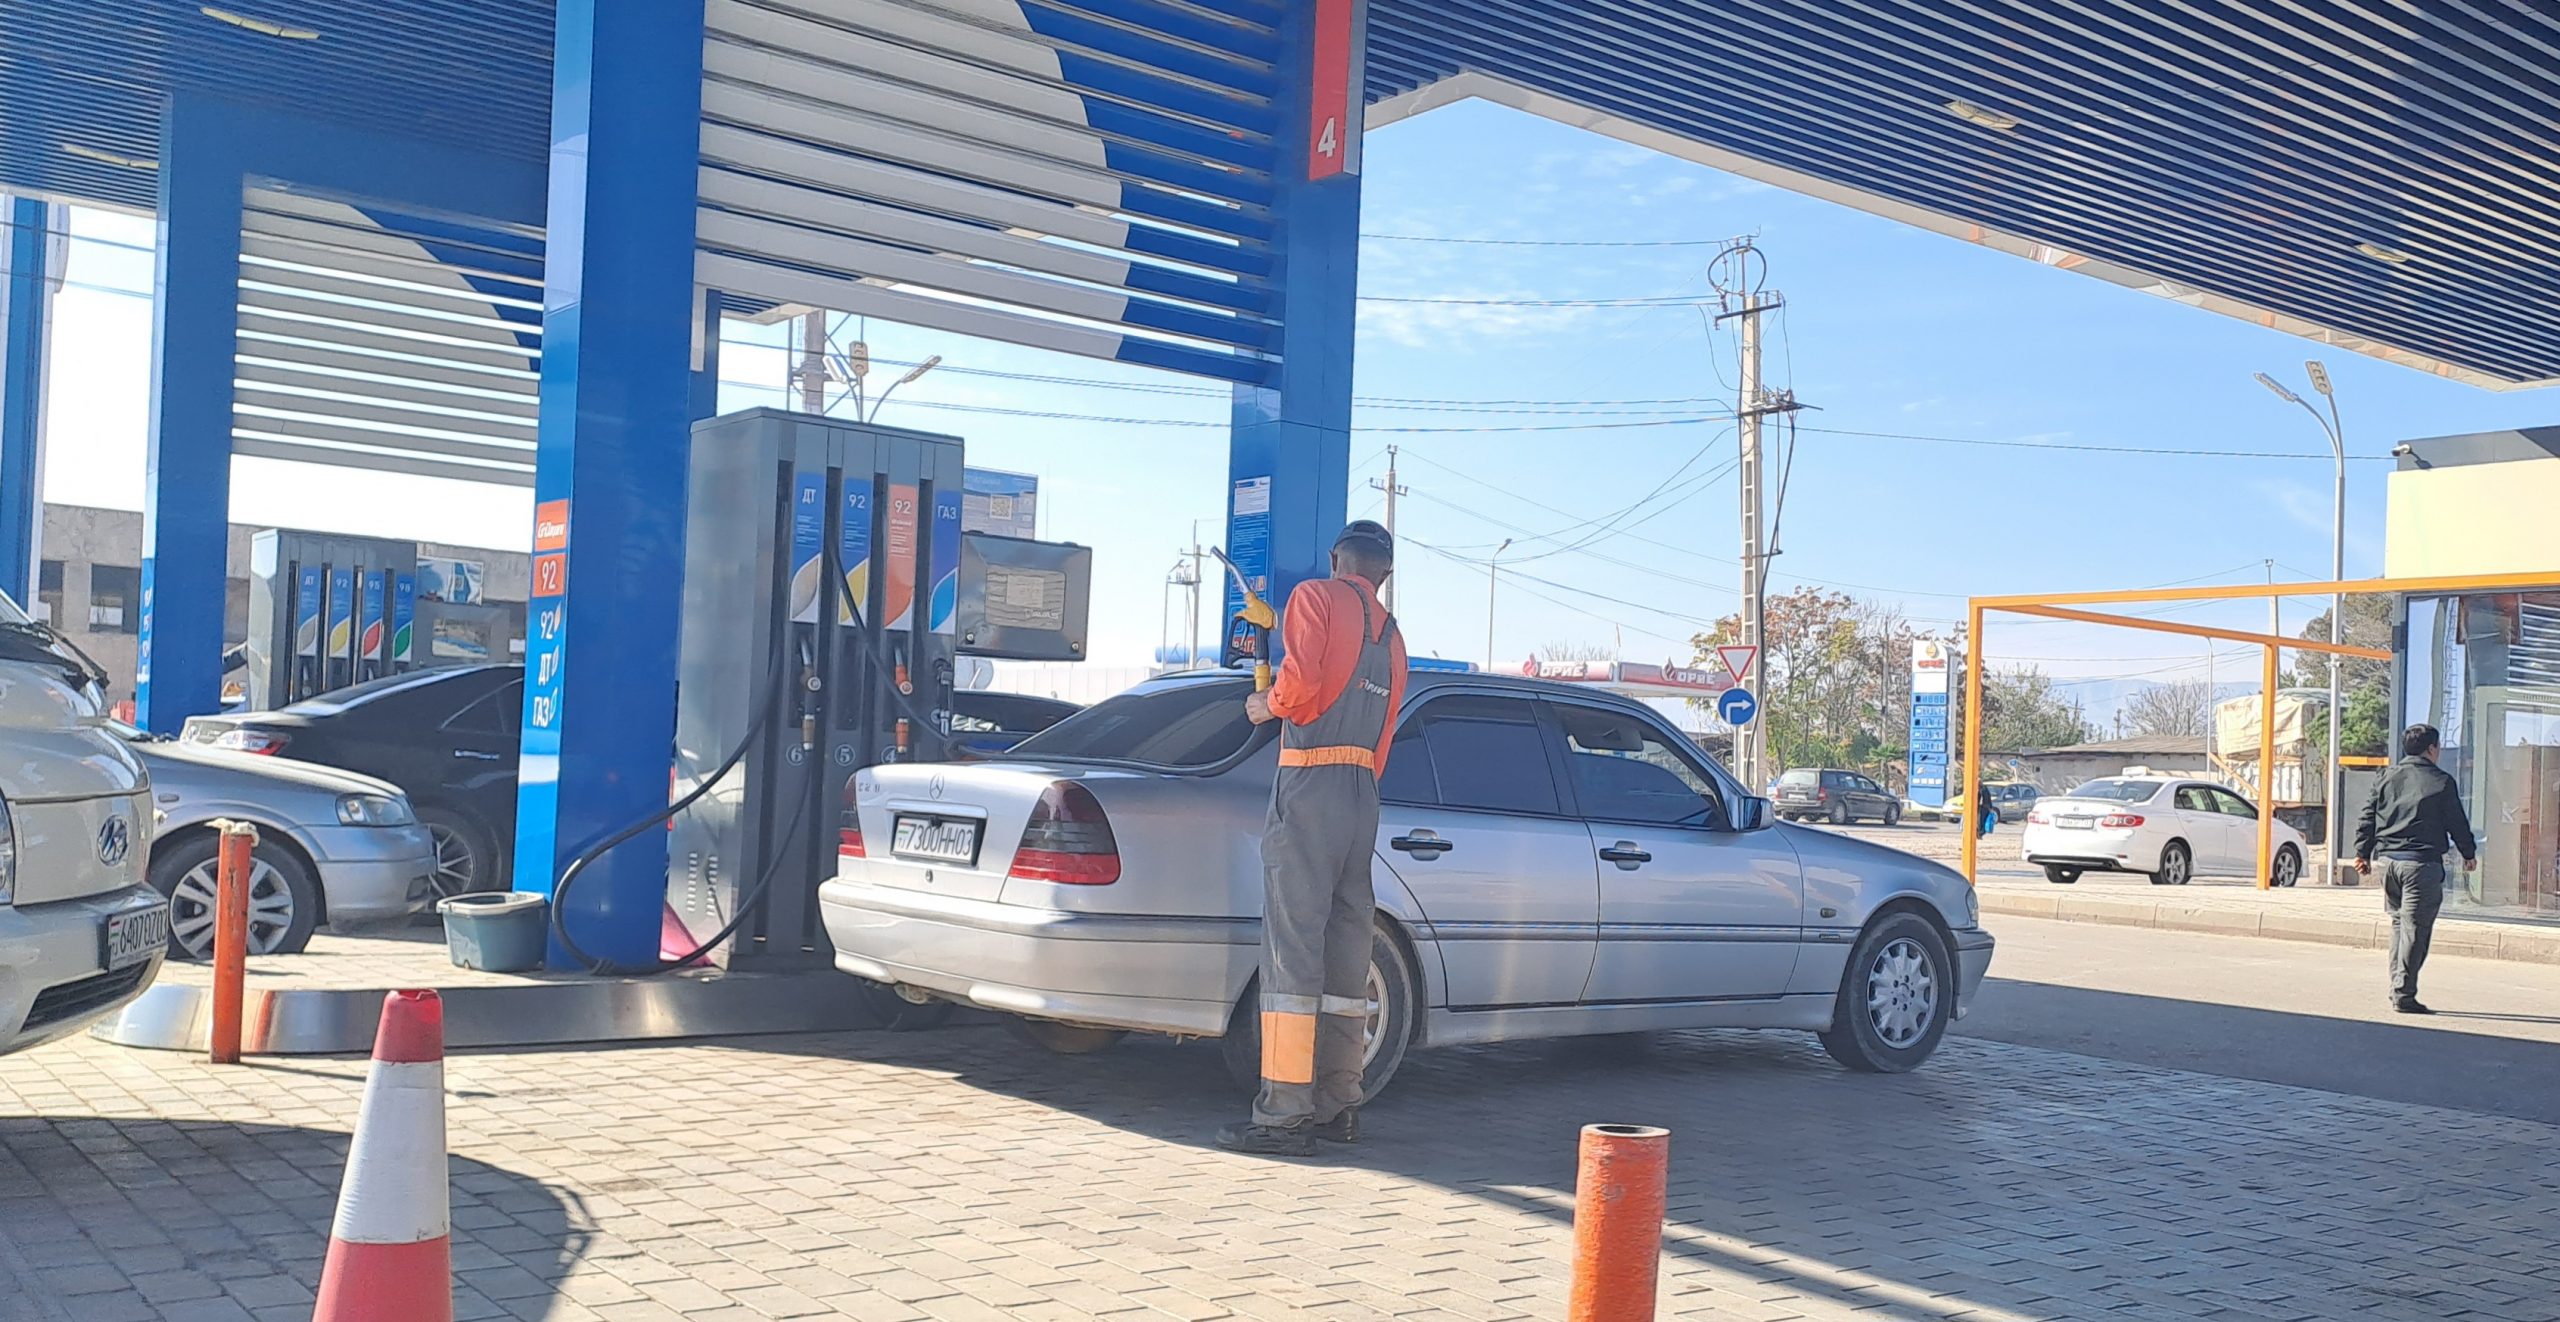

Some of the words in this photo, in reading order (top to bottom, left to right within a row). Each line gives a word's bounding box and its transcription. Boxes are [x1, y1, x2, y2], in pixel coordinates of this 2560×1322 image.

[1317, 117, 1337, 158] 4
[802, 488, 817, 505] ДТ
[848, 494, 866, 509] 92
[895, 500, 912, 515] 92
[937, 505, 957, 520] ГАЗ
[336, 578, 349, 589] 92
[541, 560, 558, 591] 92
[540, 611, 554, 640] 92
[537, 653, 551, 686] ДТ
[532, 696, 550, 728] ГАЗ
[791, 749, 803, 762] 6
[839, 748, 851, 763] 5
[884, 751, 897, 763] 4
[905, 823, 974, 857] 7300HH03
